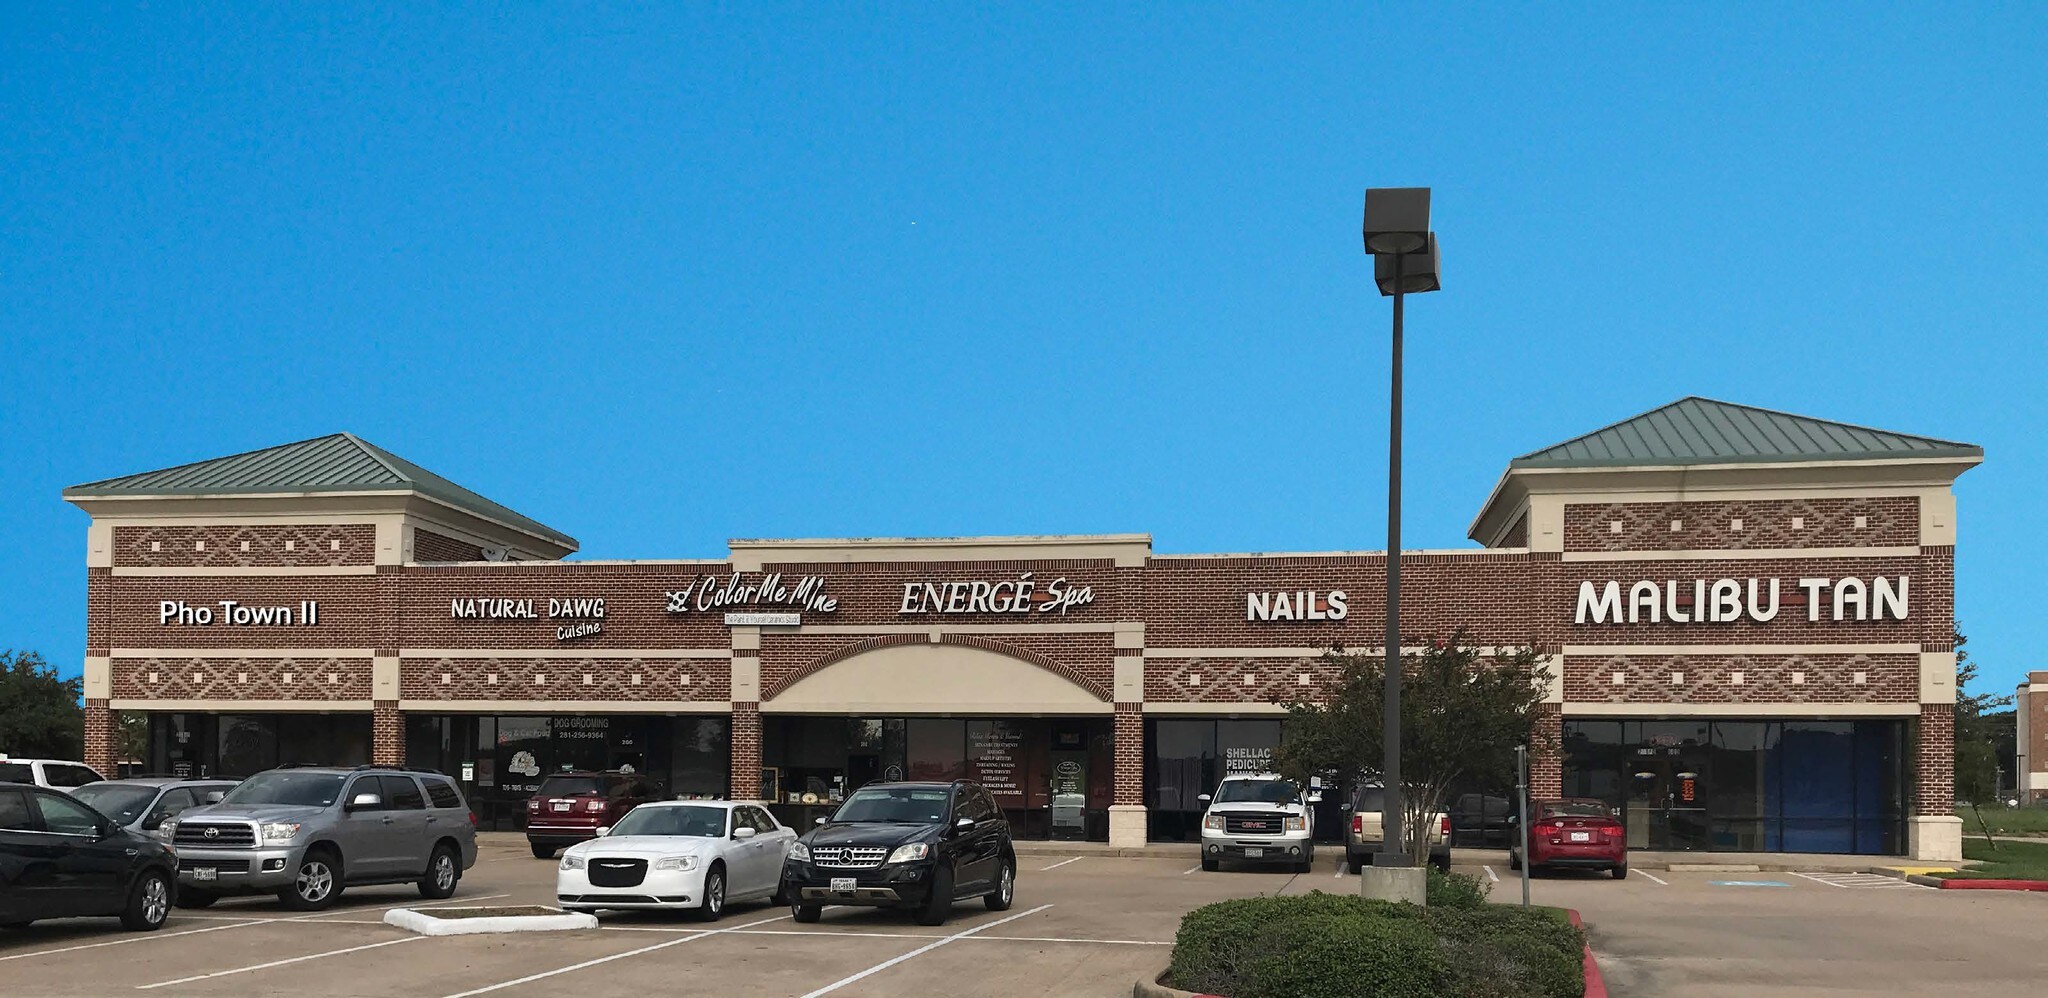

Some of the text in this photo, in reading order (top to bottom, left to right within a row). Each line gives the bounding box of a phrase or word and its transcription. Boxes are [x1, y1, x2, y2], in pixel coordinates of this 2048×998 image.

[696, 571, 838, 612] Color Me Mine
[898, 571, 1096, 616] ENERGÉ Spa
[1574, 575, 1909, 624] MALIBU TAN
[160, 600, 317, 625] Pho Town II
[451, 597, 605, 619] NATURAL DAWG
[1247, 590, 1348, 621] NAILS
[556, 622, 601, 641] Cuisine
[554, 718, 609, 728] DOG GROOMING
[1226, 747, 1271, 758] SHELLAC
[1226, 759, 1271, 770] PEDICURE
[1241, 821, 1267, 829] GMC
